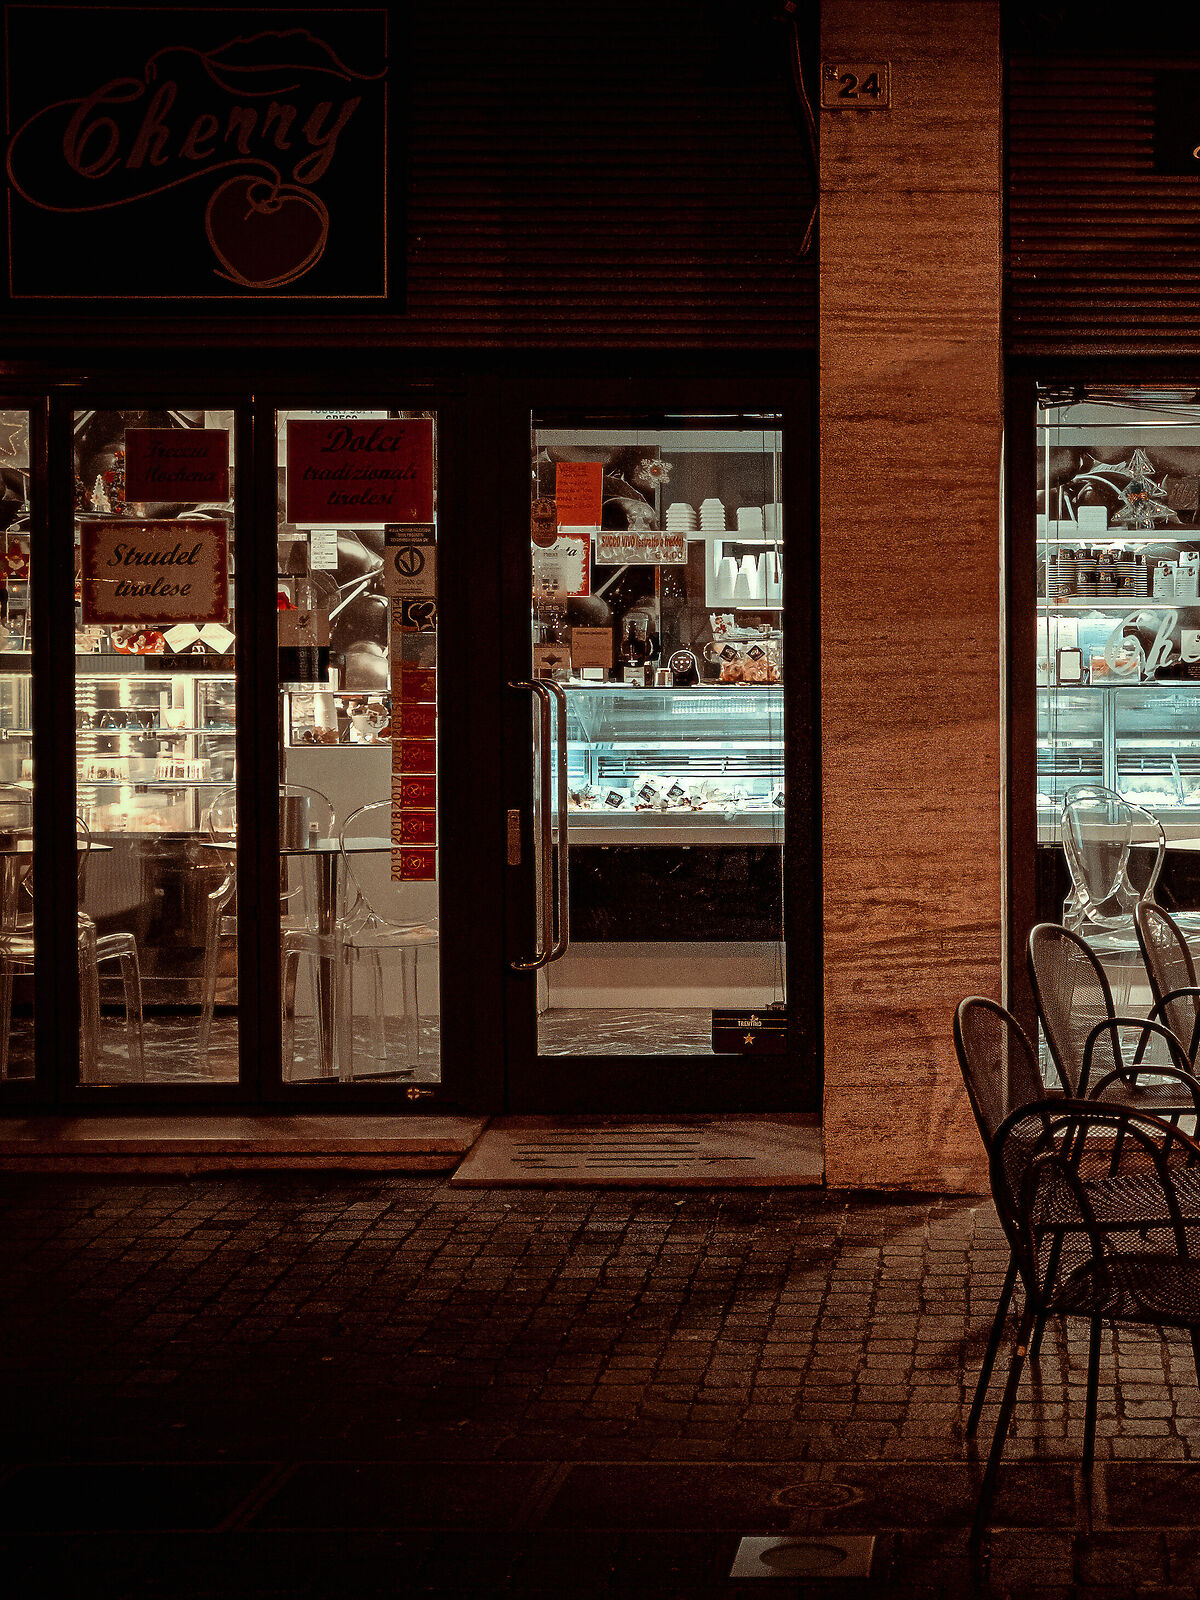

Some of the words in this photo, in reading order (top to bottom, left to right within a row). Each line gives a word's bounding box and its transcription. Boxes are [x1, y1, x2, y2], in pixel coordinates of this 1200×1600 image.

[839, 72, 880, 98] 24
[62, 77, 363, 184] Cherry
[320, 425, 404, 452] Dolci
[107, 543, 202, 566] Strudel
[115, 577, 191, 597] tirolese
[392, 597, 402, 625] 2014
[391, 775, 401, 810] 2017
[391, 812, 401, 845] 2018
[391, 848, 401, 881] 2019
